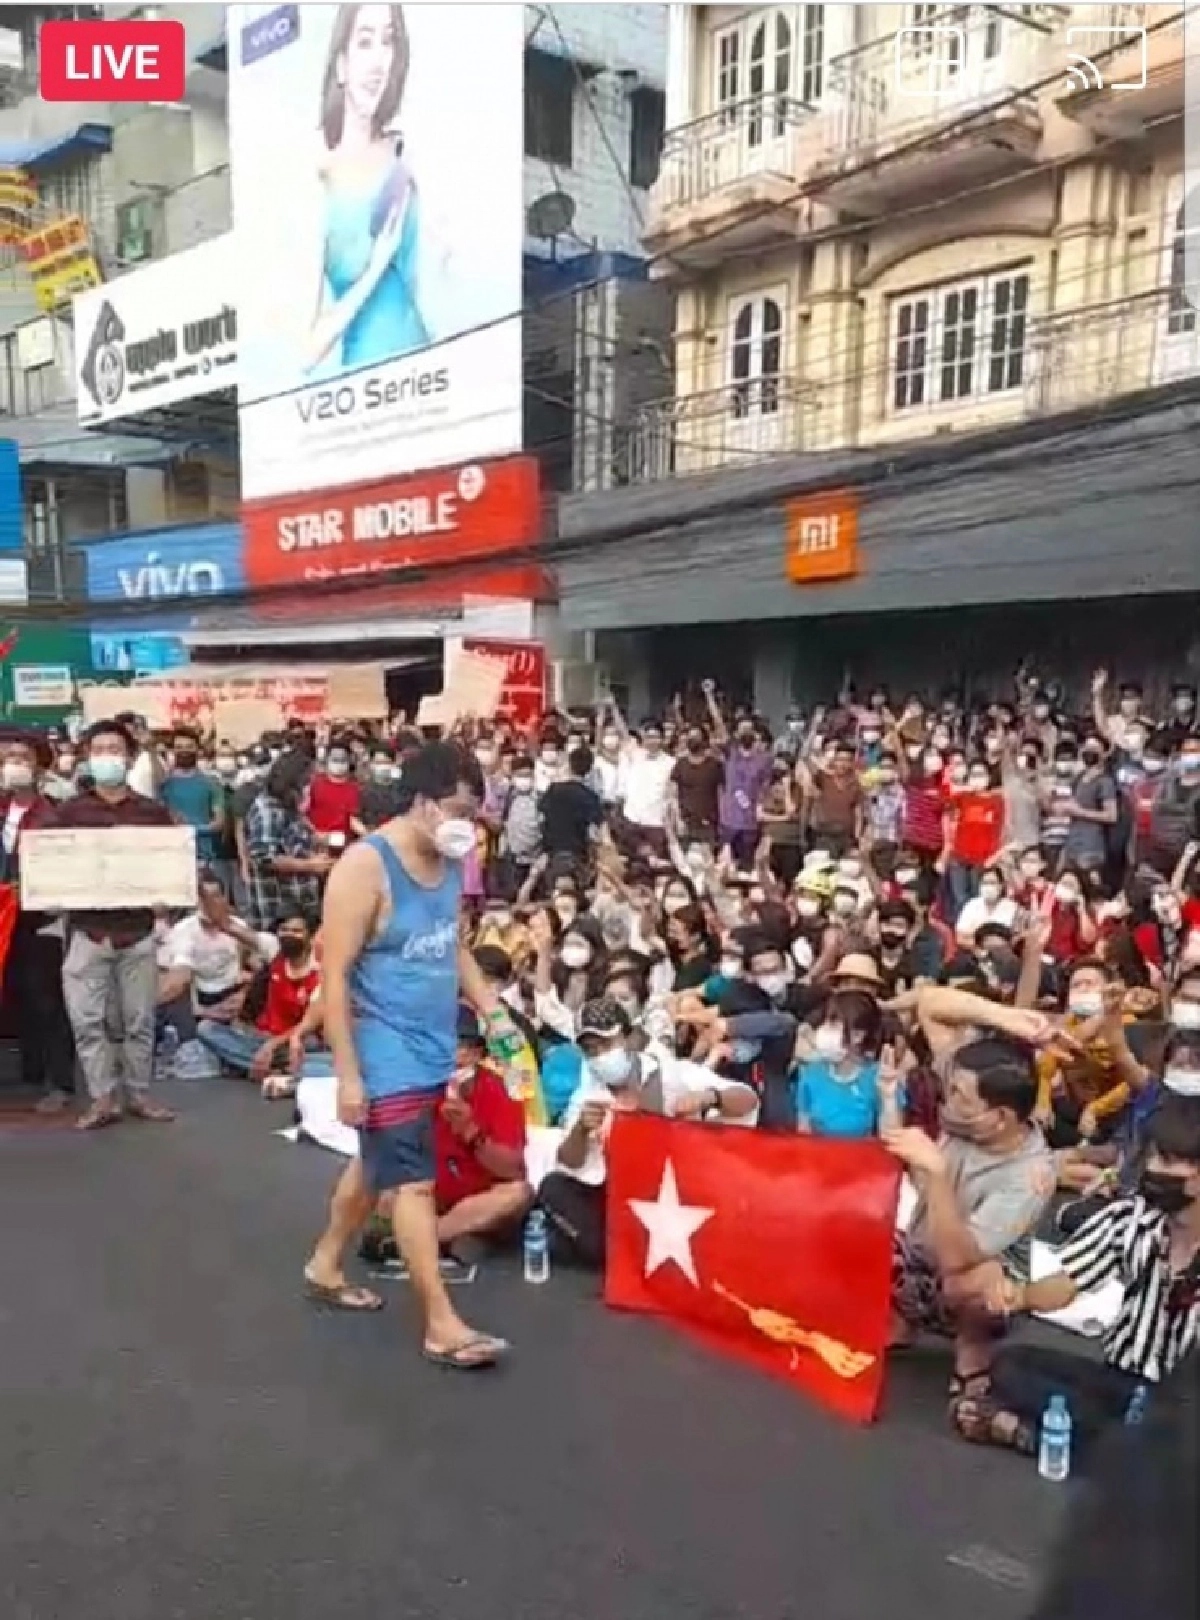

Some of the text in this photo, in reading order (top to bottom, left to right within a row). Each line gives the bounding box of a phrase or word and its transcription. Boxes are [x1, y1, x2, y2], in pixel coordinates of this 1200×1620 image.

[295, 367, 449, 423] V20 Series
[279, 491, 460, 551] STAR MOBILE
[117, 551, 225, 599] vivo
